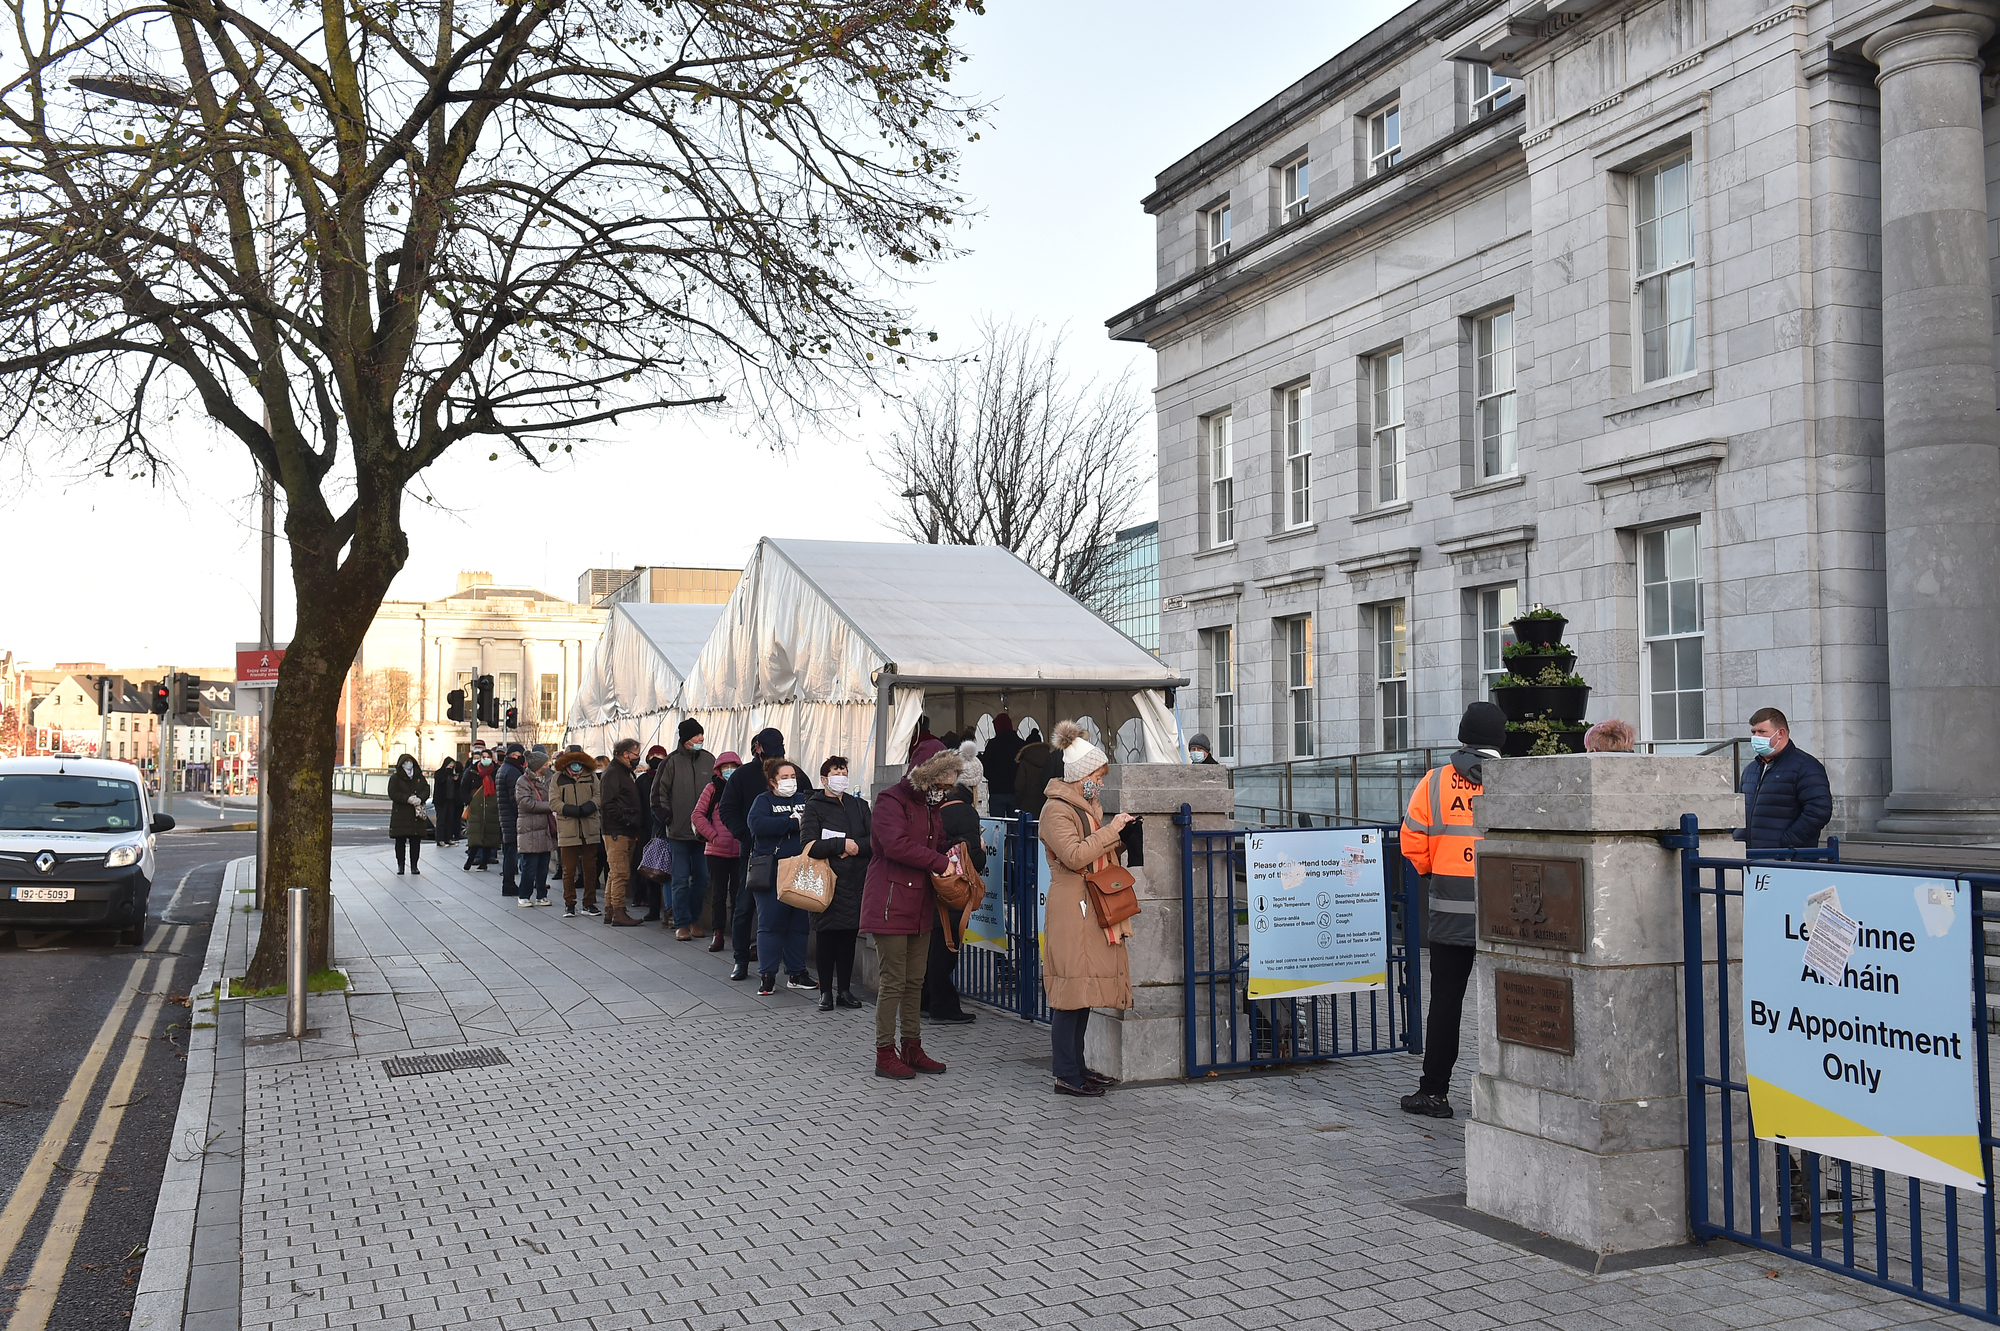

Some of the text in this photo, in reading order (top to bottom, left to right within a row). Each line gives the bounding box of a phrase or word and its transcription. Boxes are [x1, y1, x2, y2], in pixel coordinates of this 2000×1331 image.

[489, 622, 531, 630] SAVINGS
[1463, 847, 1473, 862] 6
[1321, 860, 1339, 869] today
[1254, 872, 1267, 880] any
[1268, 871, 1275, 879] of
[1755, 873, 1771, 891] HSE
[21, 890, 69, 899] 192-C-5093
[1850, 920, 1916, 953] inne
[1801, 962, 1900, 995] Aháin
[1751, 999, 1962, 1060] By Appointment
[1823, 1053, 1881, 1094] Only
